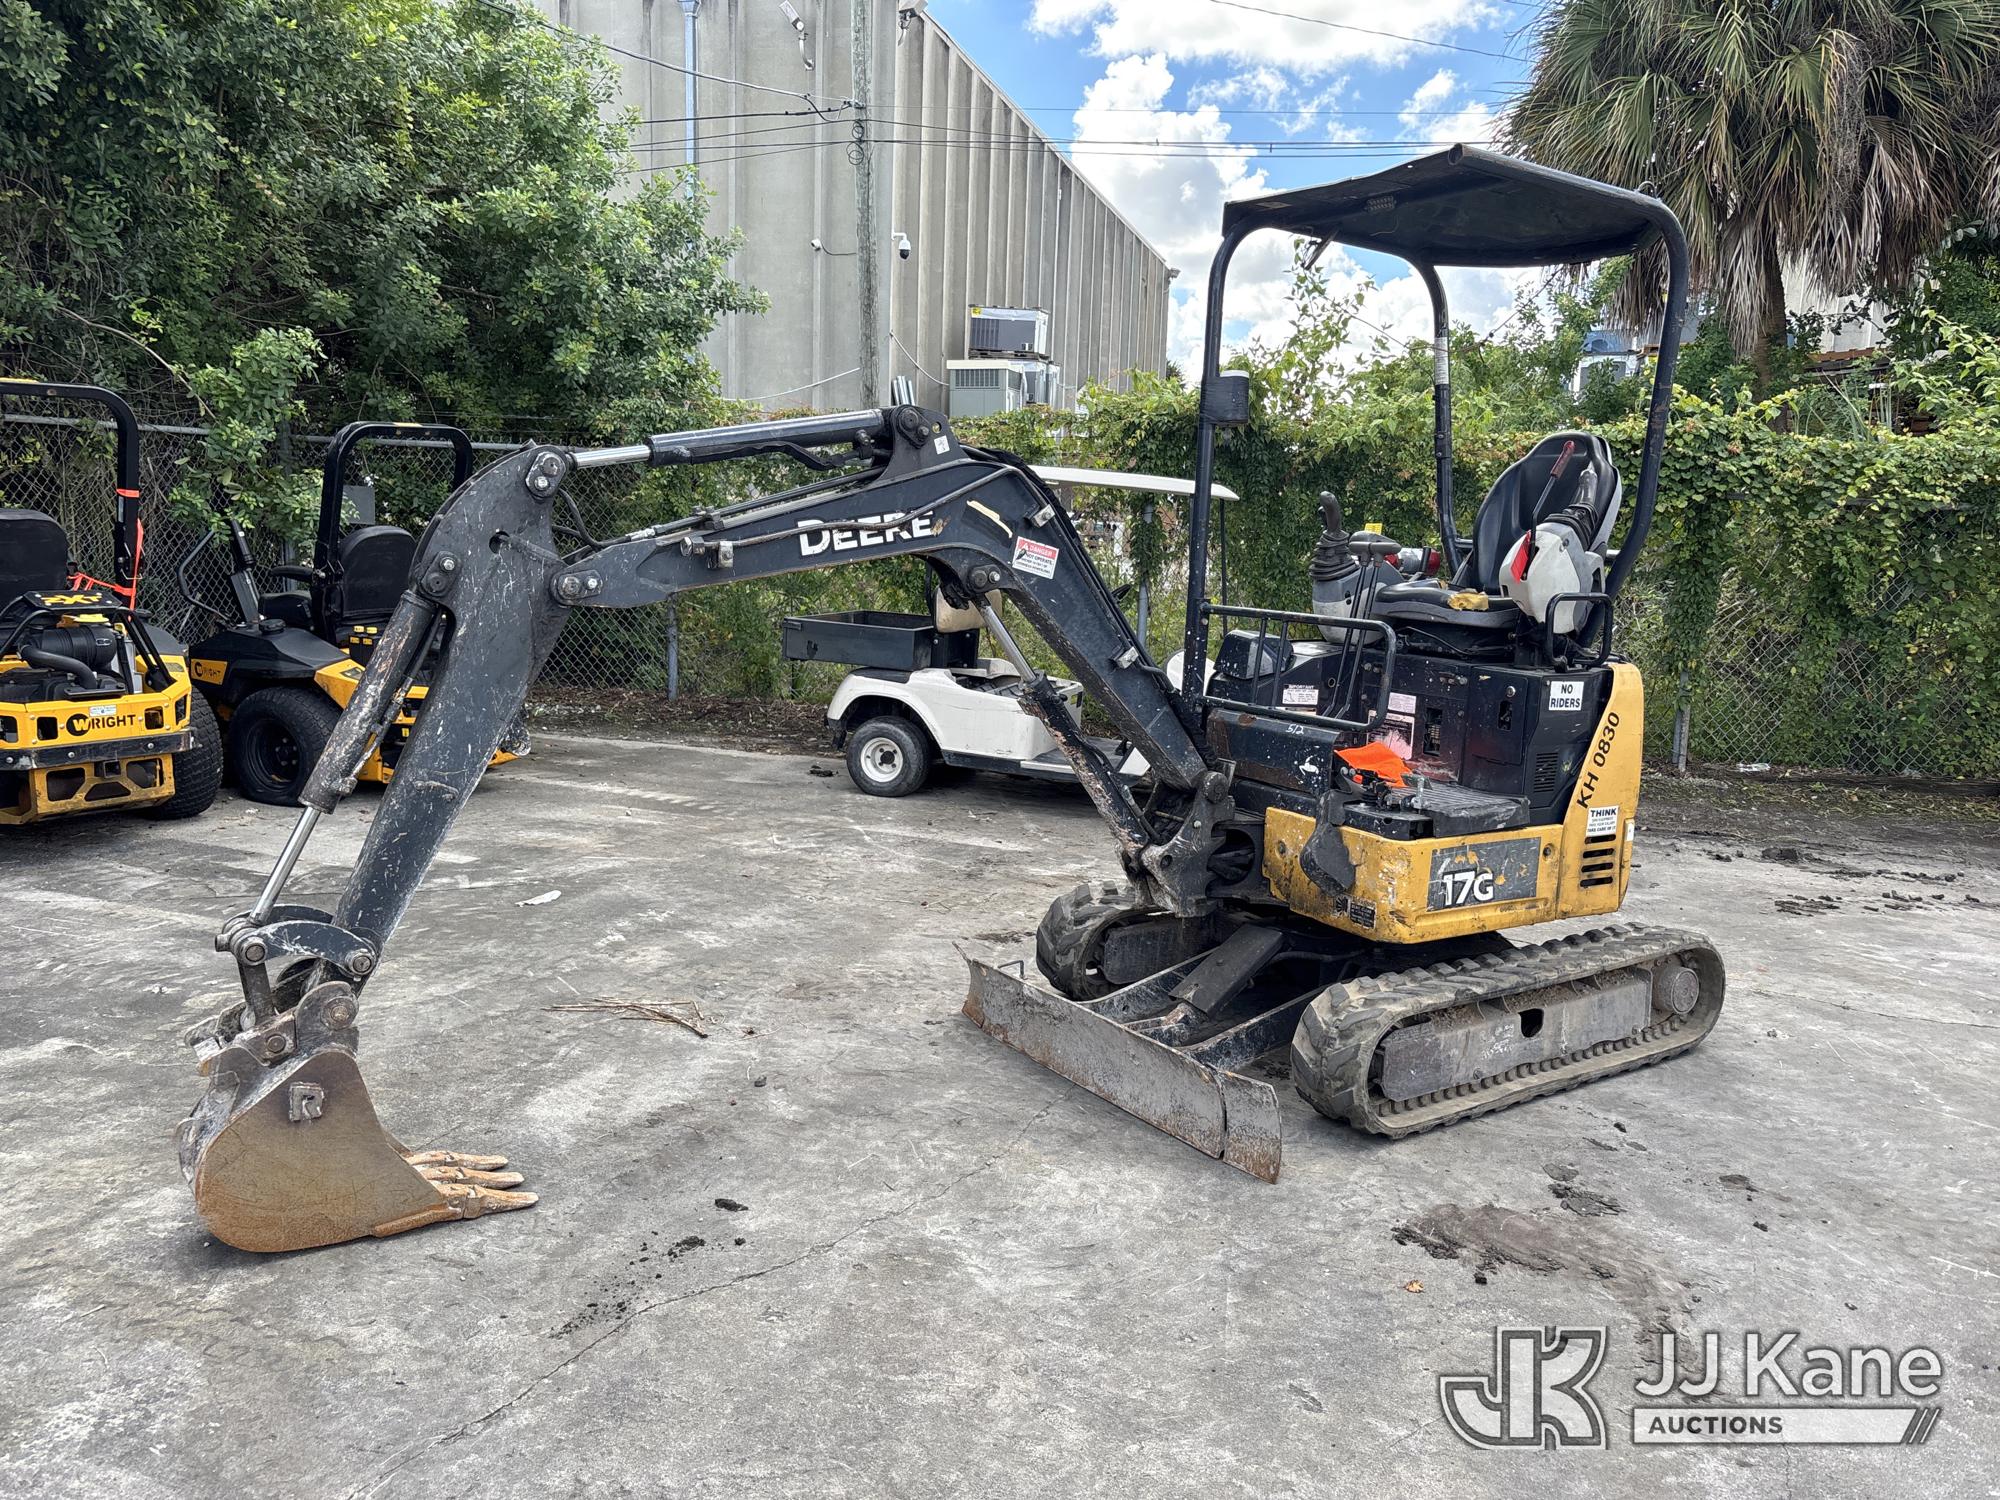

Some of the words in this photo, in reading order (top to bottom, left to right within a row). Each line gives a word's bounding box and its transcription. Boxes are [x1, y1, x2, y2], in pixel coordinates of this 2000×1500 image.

[797, 510, 934, 556] DEERE
[1561, 684, 1573, 694] NO
[1550, 698, 1580, 708] RIDERS
[66, 713, 136, 737] WRIGHT
[1577, 771, 1599, 808] KH
[1593, 712, 1620, 767] 0830
[1590, 807, 1616, 817] THINK
[1443, 870, 1494, 906] 17G
